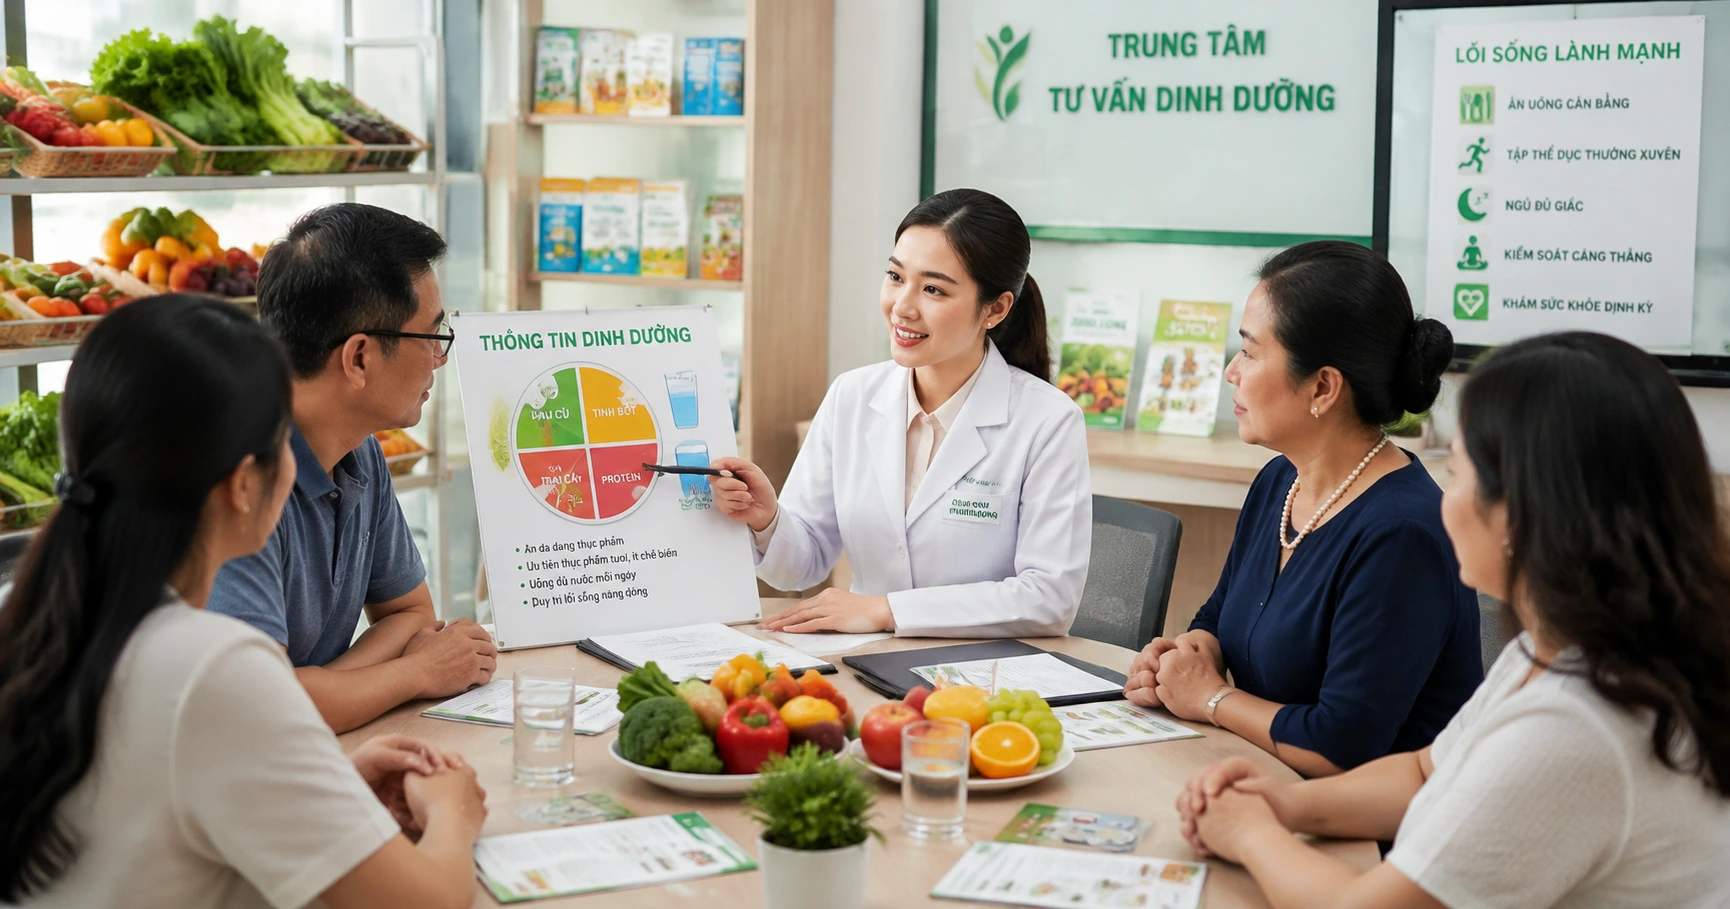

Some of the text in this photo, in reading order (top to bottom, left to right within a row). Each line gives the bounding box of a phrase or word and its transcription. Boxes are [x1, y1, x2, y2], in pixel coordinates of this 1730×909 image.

[1108, 24, 1265, 58] TRUNG TÂM
[1555, 40, 1609, 61] LÀNH
[1618, 42, 1680, 64] MẠNH
[1049, 77, 1335, 112] TƯ VẤN DINH DƯỠNG
[1557, 149, 1581, 163] DỤC
[479, 328, 544, 351] THÔNG
[547, 331, 577, 348] TIN
[582, 329, 625, 347] DINH
[601, 473, 641, 484] PROTEIN
